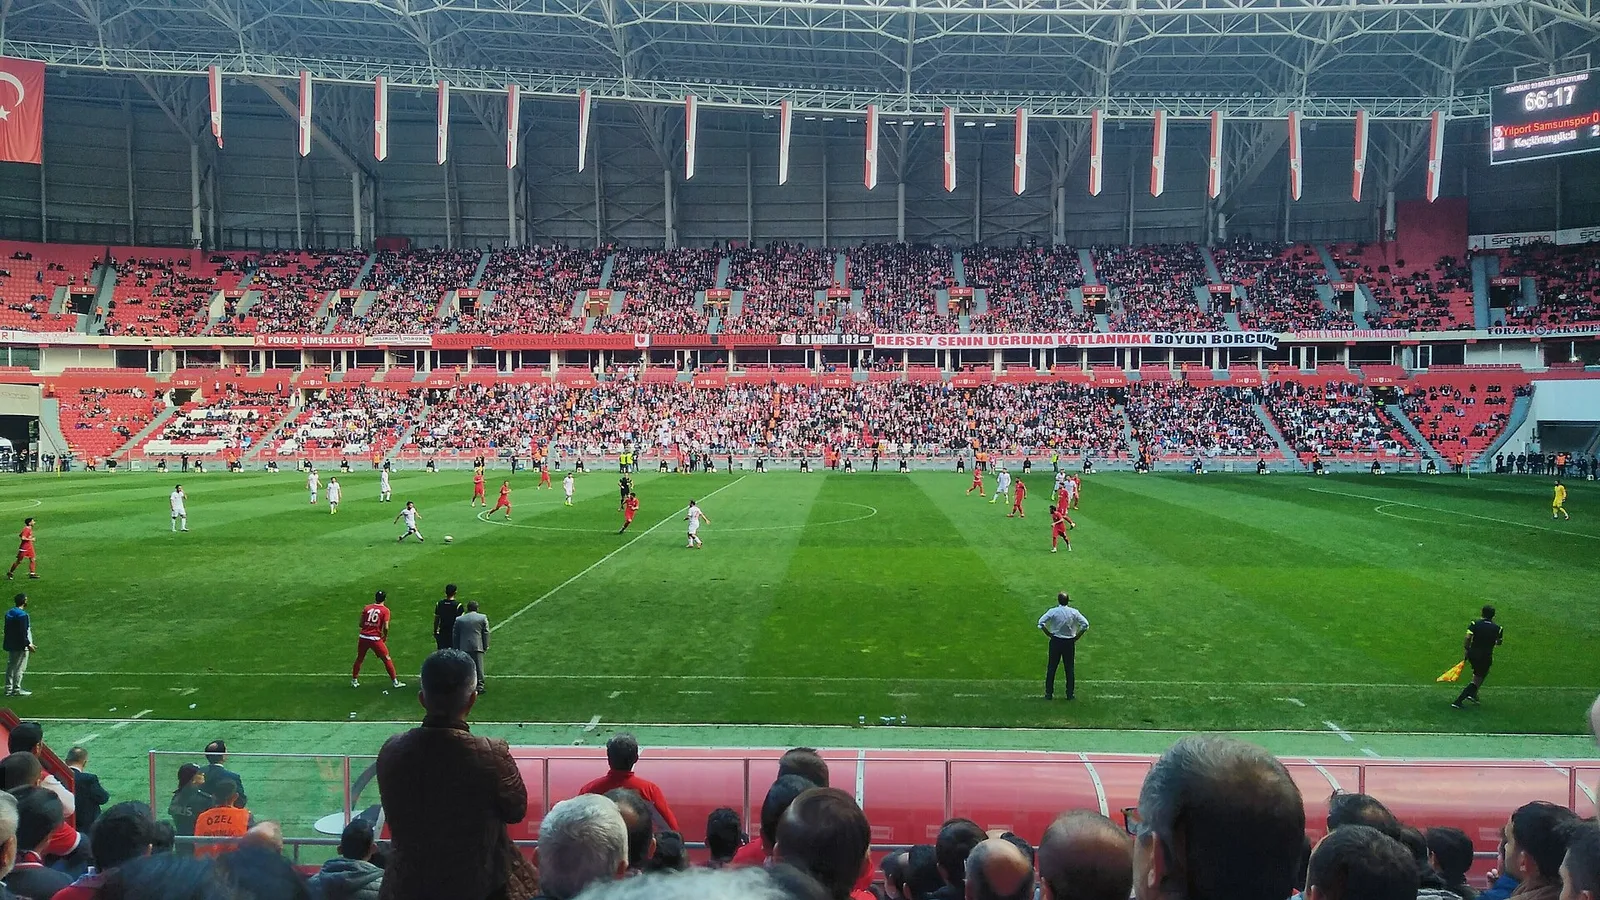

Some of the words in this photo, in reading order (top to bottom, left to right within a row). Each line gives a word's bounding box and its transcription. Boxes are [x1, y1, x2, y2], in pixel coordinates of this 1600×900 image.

[1525, 85, 1576, 111] 66:17
[1534, 115, 1590, 131] Samsunspor
[1593, 113, 1599, 123] 0
[1592, 125, 1600, 136] 2
[1554, 324, 1600, 333] AKADE
[268, 336, 299, 344] FORZA
[301, 335, 354, 345] ŞİMŞEKLER
[437, 337, 505, 346] SAMSUNSPOR
[507, 337, 585, 346] TARAFTARLAR
[800, 335, 810, 344] 10
[811, 335, 838, 344] KASIM
[1058, 334, 1151, 345] KATLANMAK
[1155, 334, 1207, 344] BOYUN
[1211, 333, 1279, 347] BORCUM
[367, 608, 381, 623] 16
